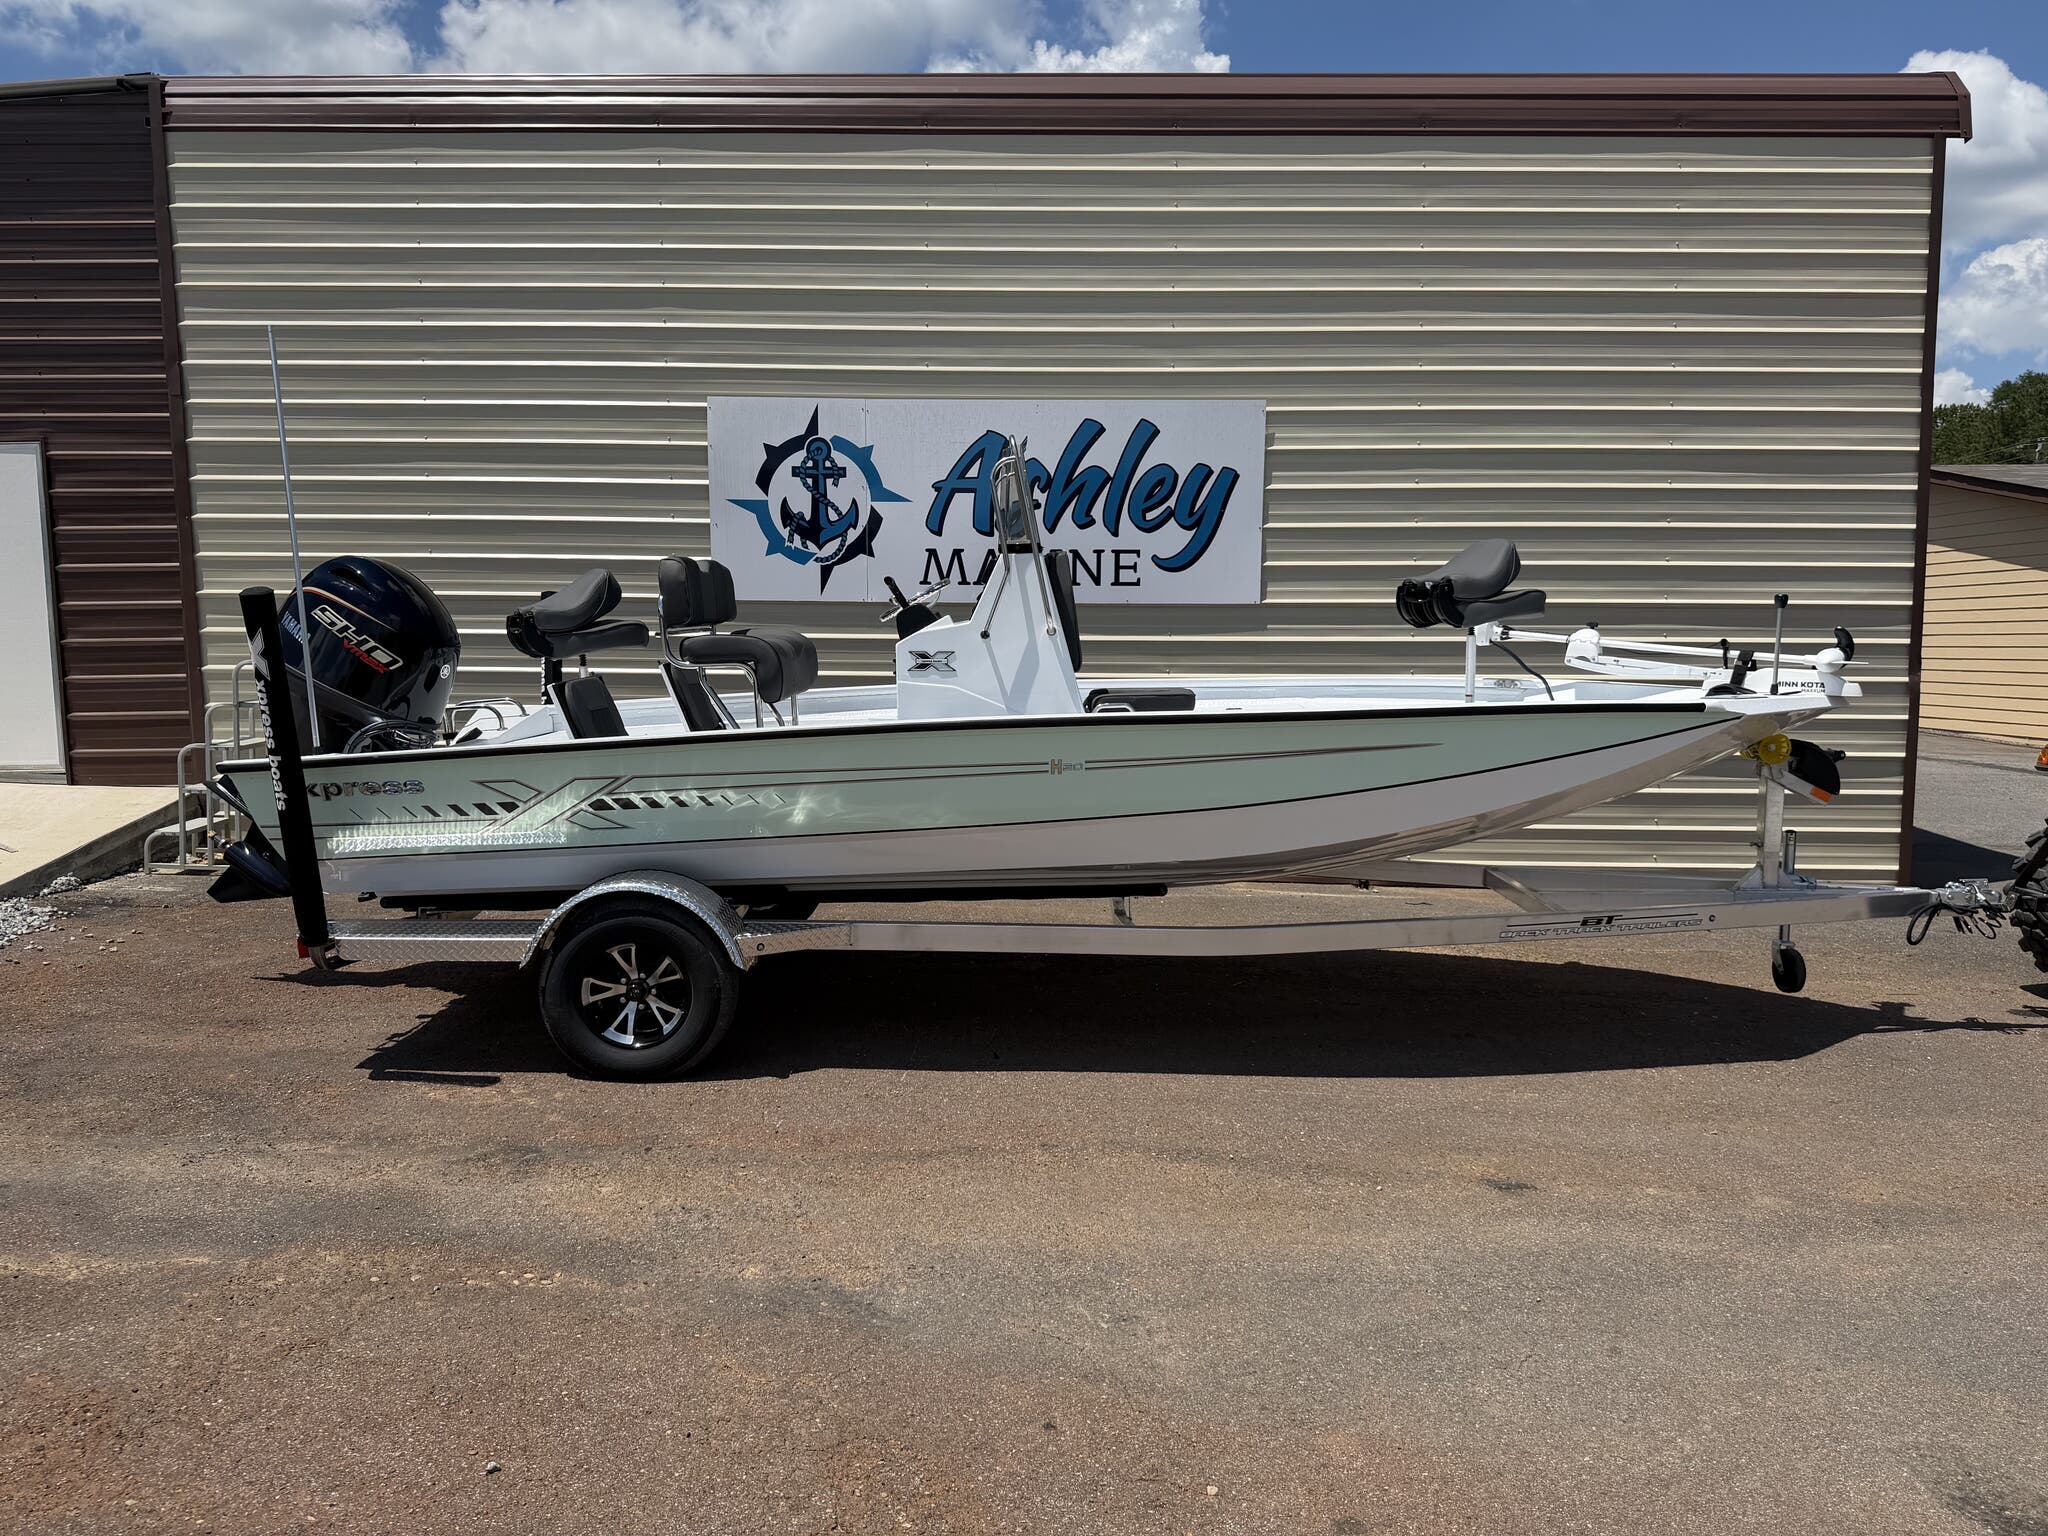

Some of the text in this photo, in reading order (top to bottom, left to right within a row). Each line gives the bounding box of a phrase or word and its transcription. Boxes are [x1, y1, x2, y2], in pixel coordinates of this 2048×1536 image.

[310, 604, 404, 670] SHO
[1800, 681, 1826, 689] KOTA
[255, 679, 276, 750] xpress
[268, 754, 288, 812] boats
[1499, 918, 1703, 938] BACK TRACK TRAILERS
[1580, 914, 1623, 927] BT
